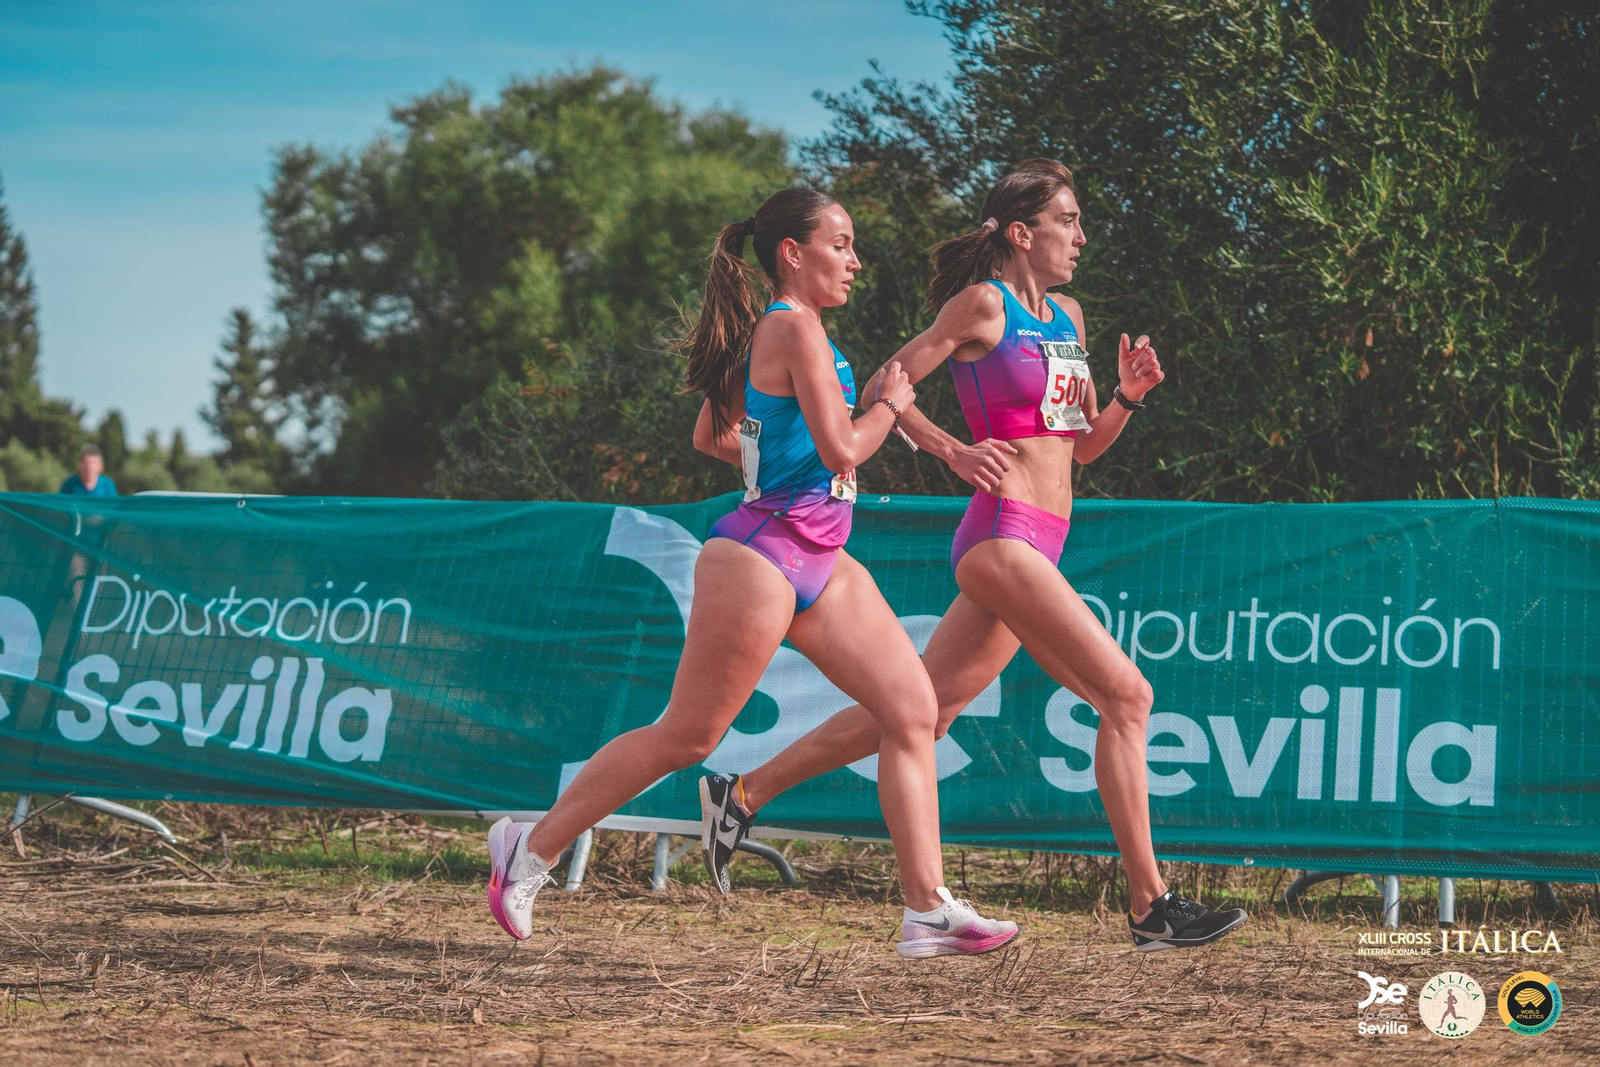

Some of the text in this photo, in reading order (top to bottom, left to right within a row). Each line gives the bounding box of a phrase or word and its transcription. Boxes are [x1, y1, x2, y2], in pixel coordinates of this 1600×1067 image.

[1050, 374, 1086, 408] 500
[80, 573, 412, 650] Diputación
[56, 653, 393, 763] Sevilla
[1039, 685, 1498, 807] Sevilla
